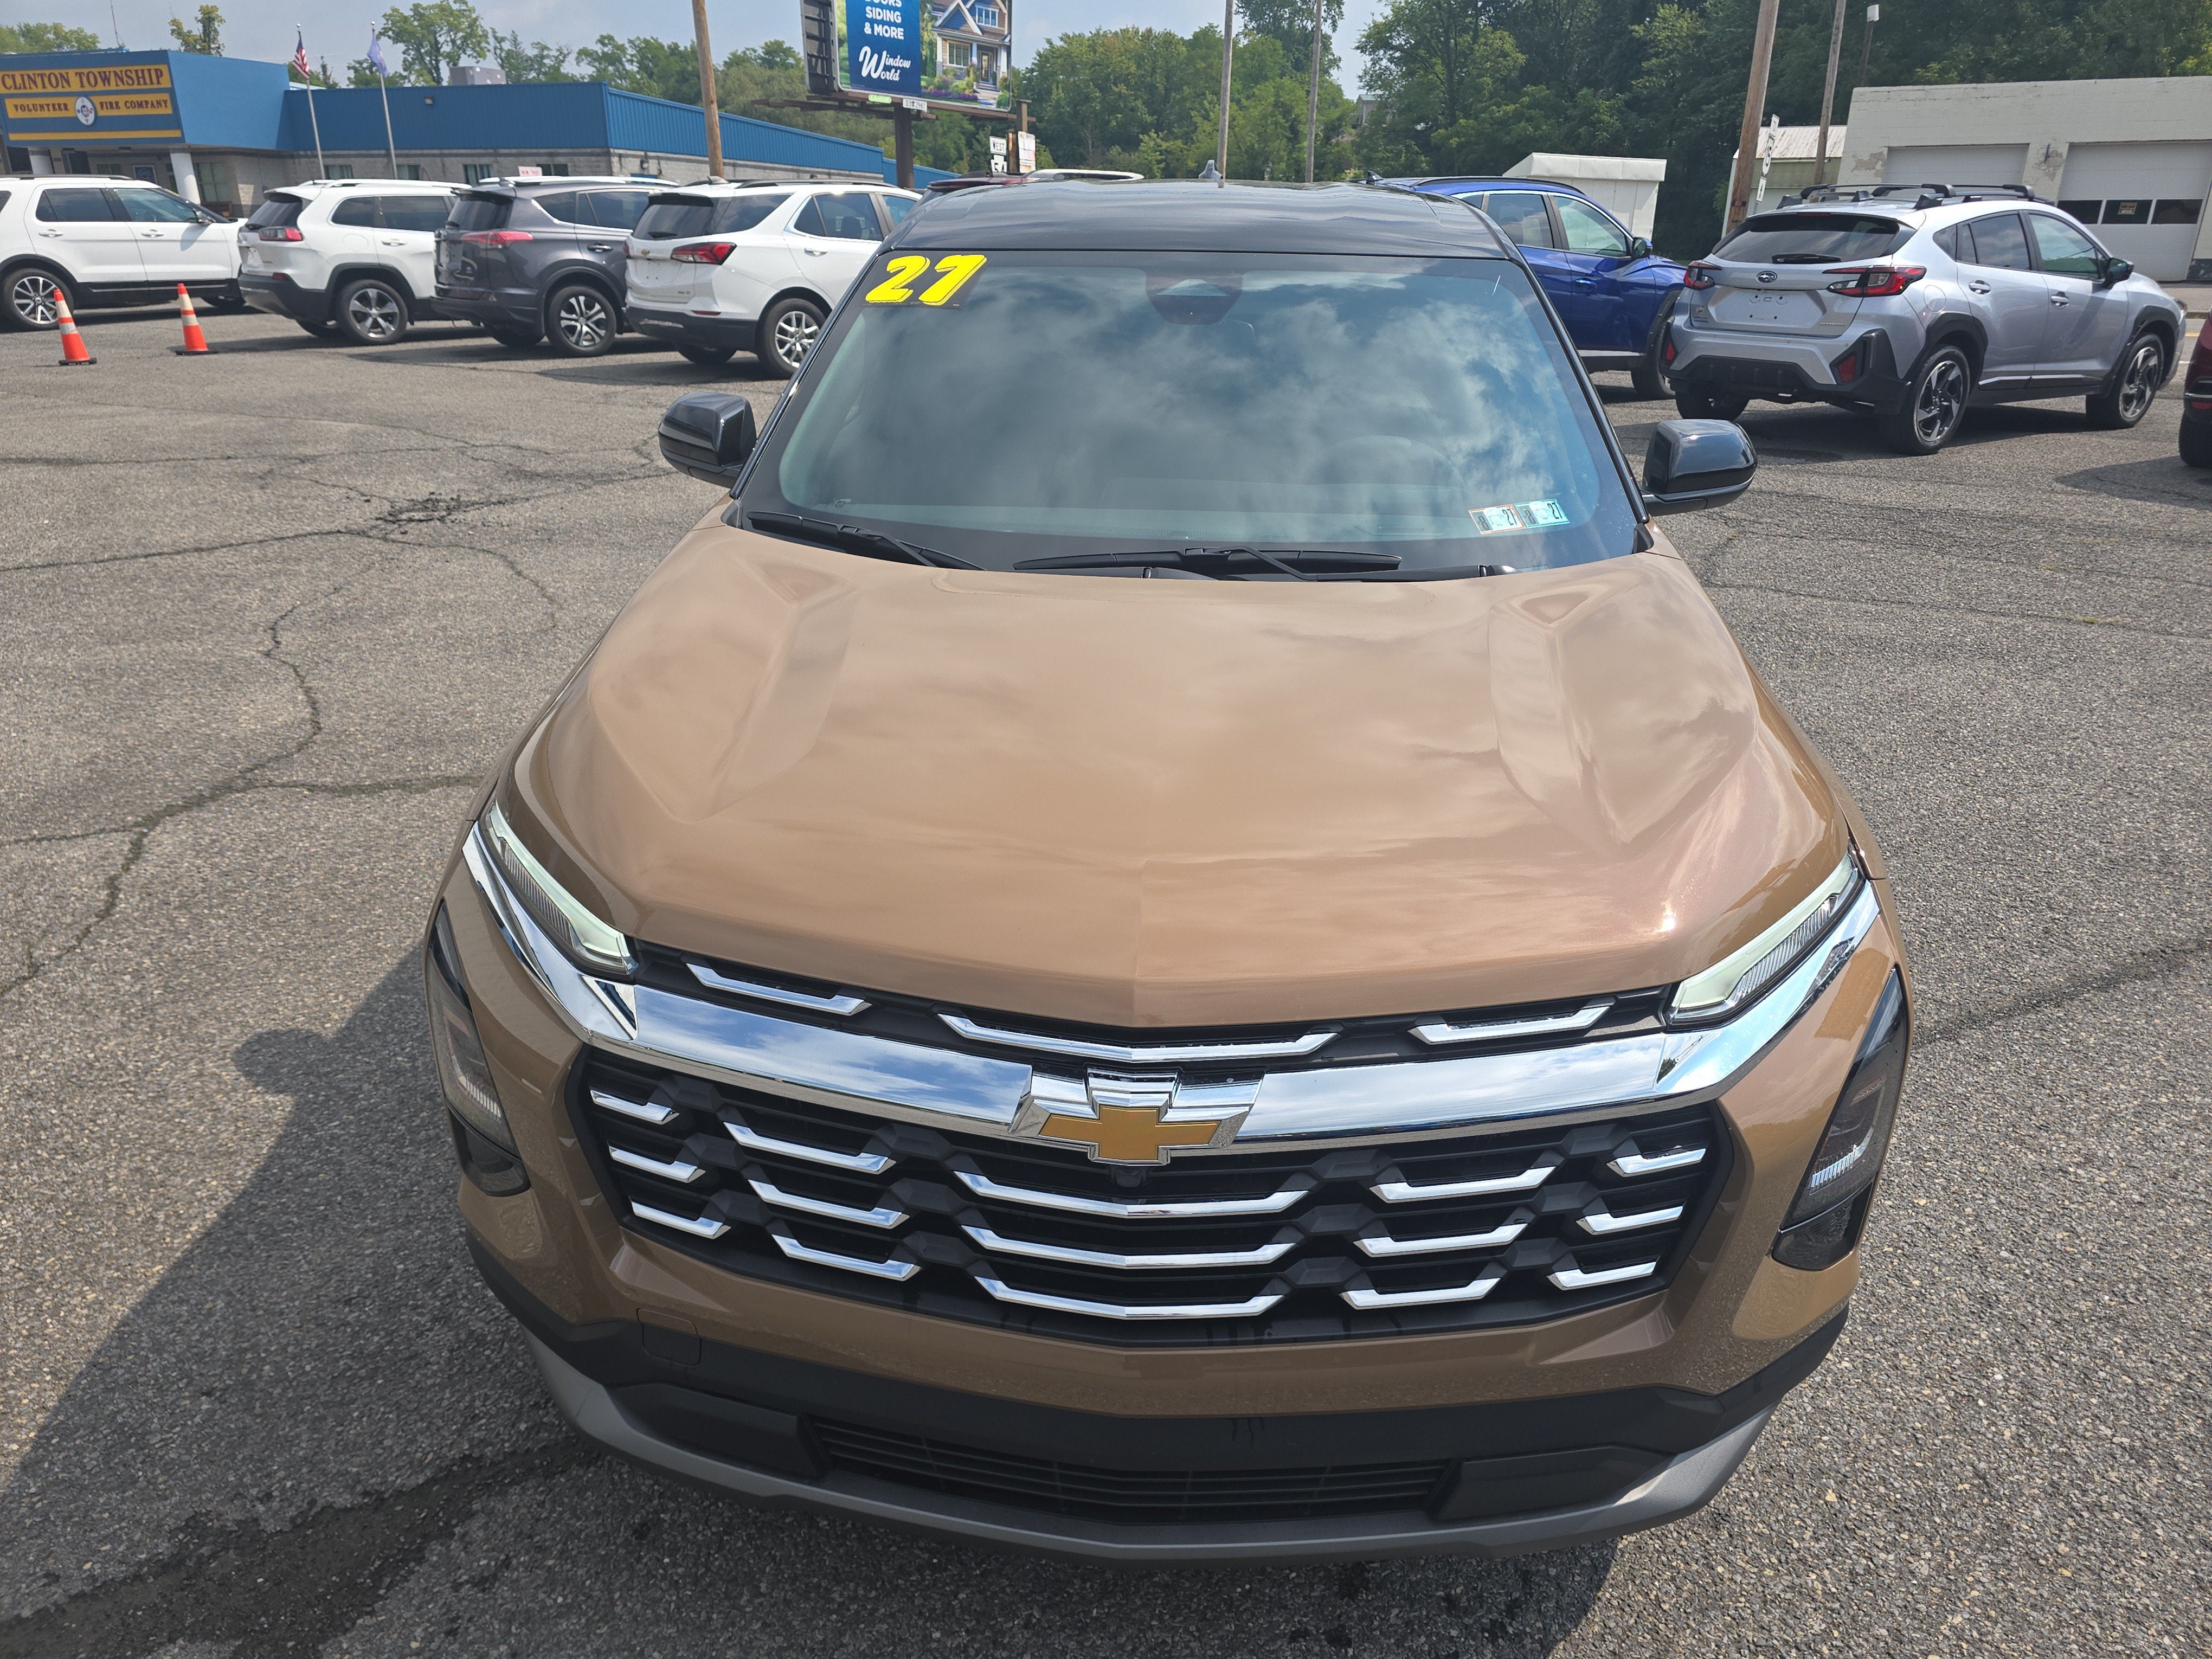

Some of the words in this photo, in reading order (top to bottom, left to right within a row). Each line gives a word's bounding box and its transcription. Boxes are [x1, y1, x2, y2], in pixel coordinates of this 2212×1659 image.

[865, 6, 902, 23] SIDING
[864, 22, 872, 34] &
[874, 23, 904, 40] MORE
[859, 46, 911, 79] Window
[1, 72, 71, 90] CLINTON
[75, 68, 164, 88] TOWNSHIP
[14, 102, 69, 112] VOLUNTEER
[99, 101, 121, 111] FIRE
[124, 99, 168, 110] COMPANY
[865, 254, 987, 306] 27
[1502, 509, 1517, 525] 27
[1547, 502, 1562, 519] 27
